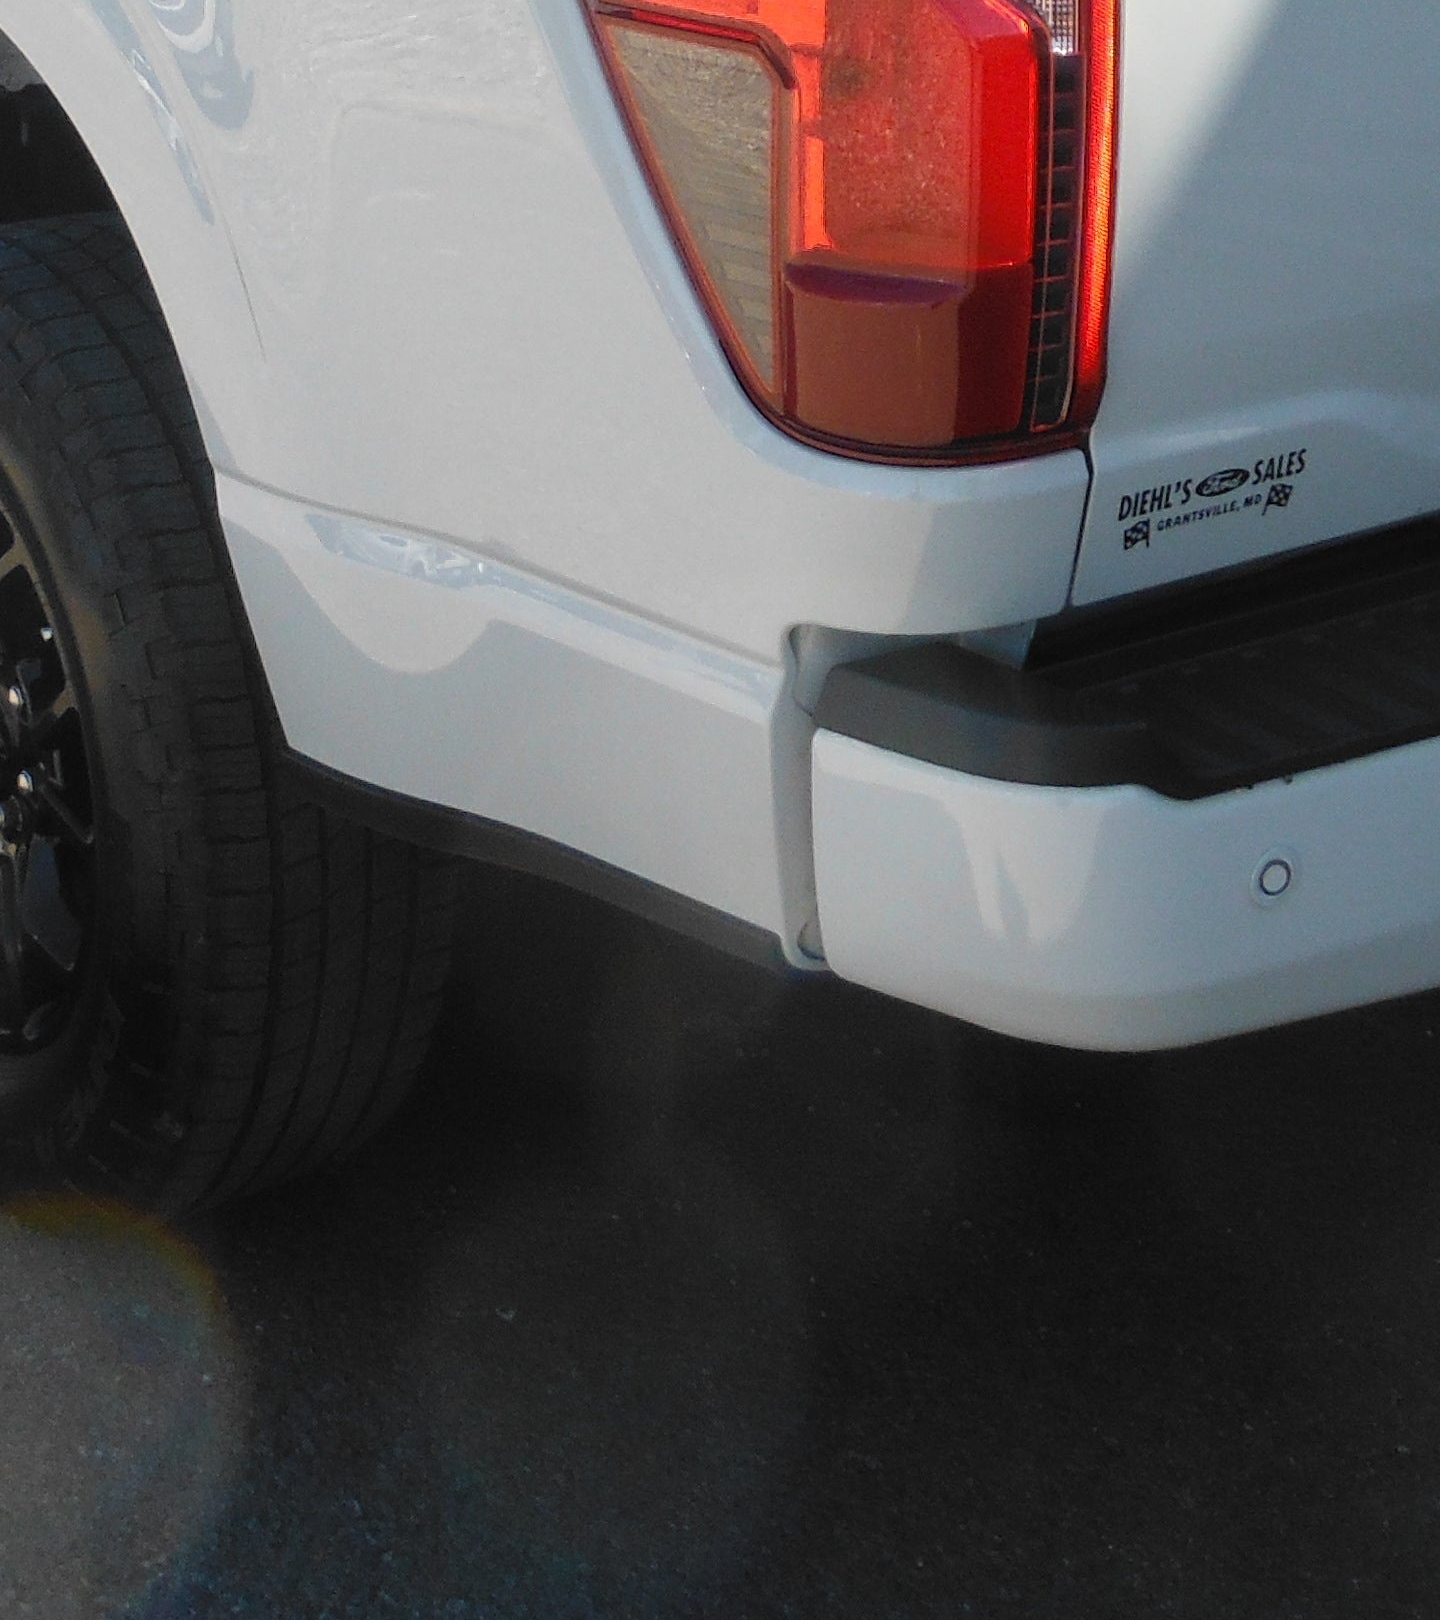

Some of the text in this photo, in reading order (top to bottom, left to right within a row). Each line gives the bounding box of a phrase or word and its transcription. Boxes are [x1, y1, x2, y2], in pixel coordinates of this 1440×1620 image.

[1117, 478, 1193, 522] DIEHL'S
[1251, 448, 1308, 485] SALES
[1242, 492, 1263, 509] MD
